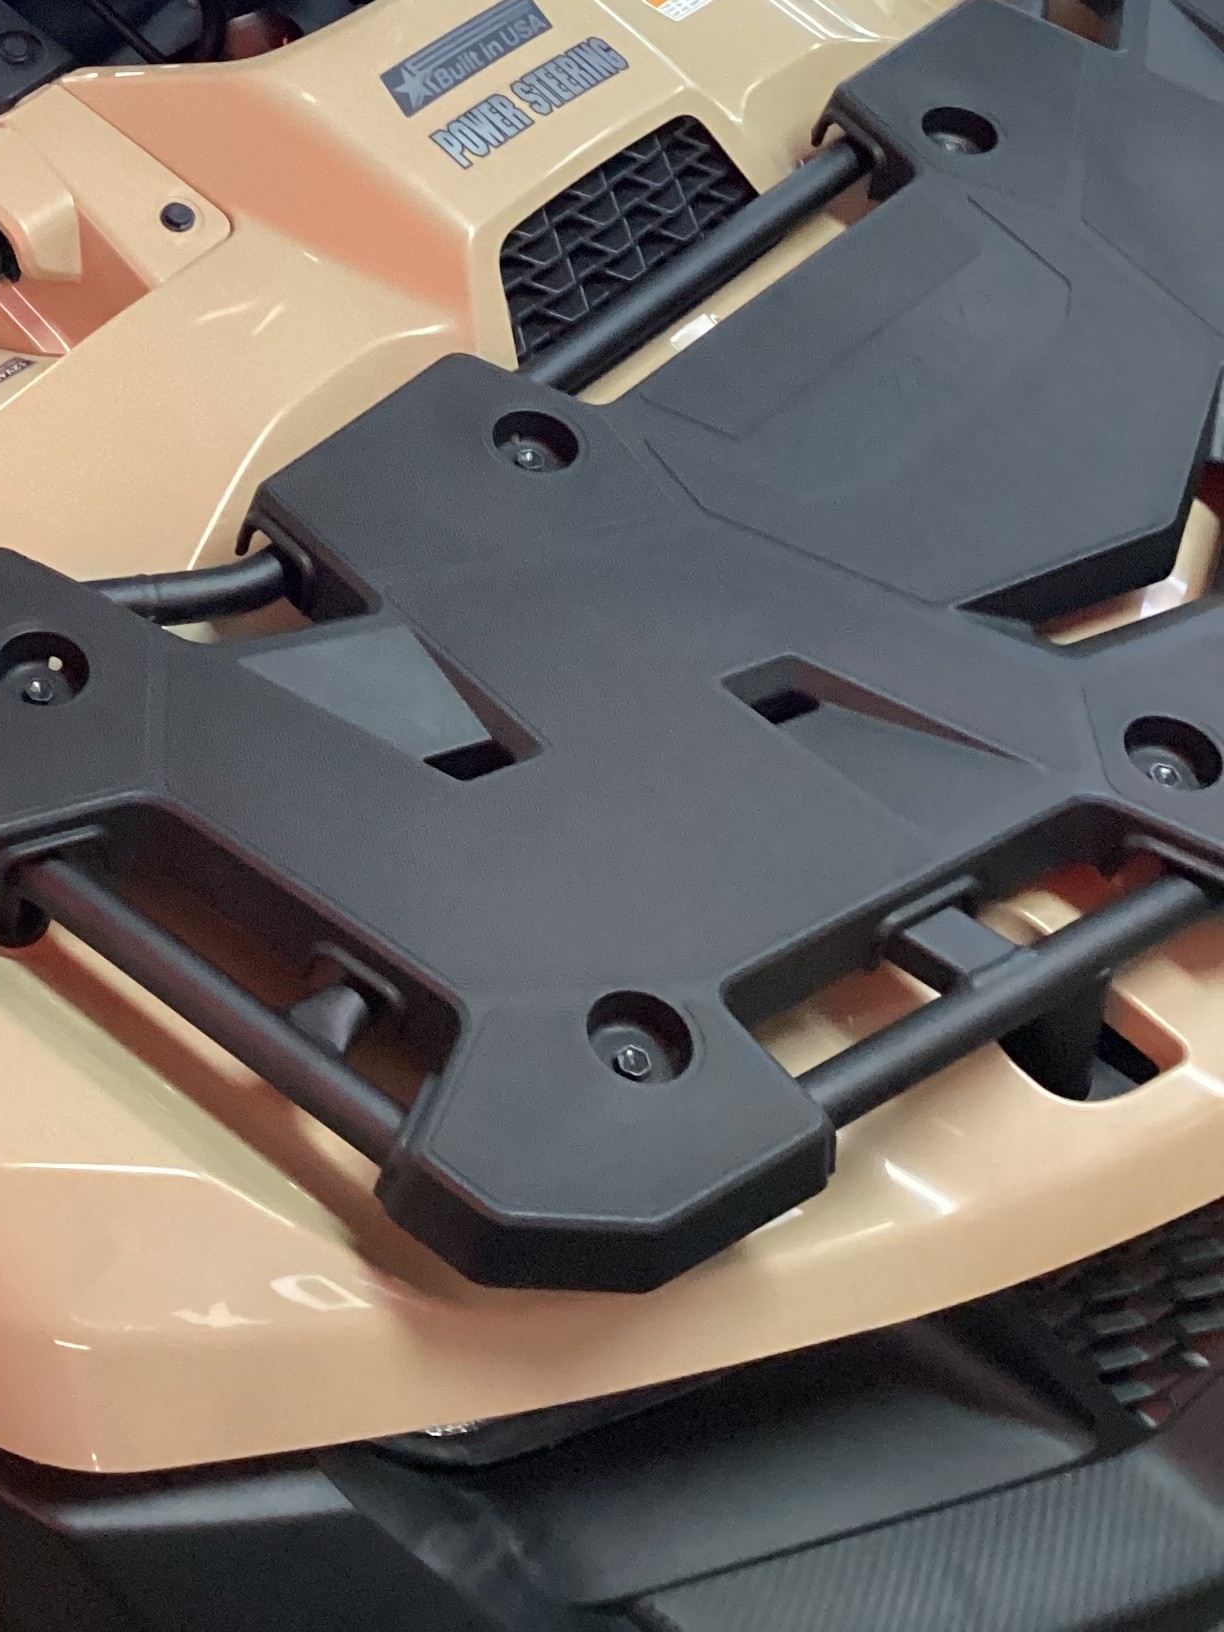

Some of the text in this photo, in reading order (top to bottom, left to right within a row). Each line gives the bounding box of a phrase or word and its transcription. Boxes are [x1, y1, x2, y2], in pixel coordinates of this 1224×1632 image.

[429, 36, 629, 170] POWER STEERING
[433, 13, 547, 92] Built in USA
